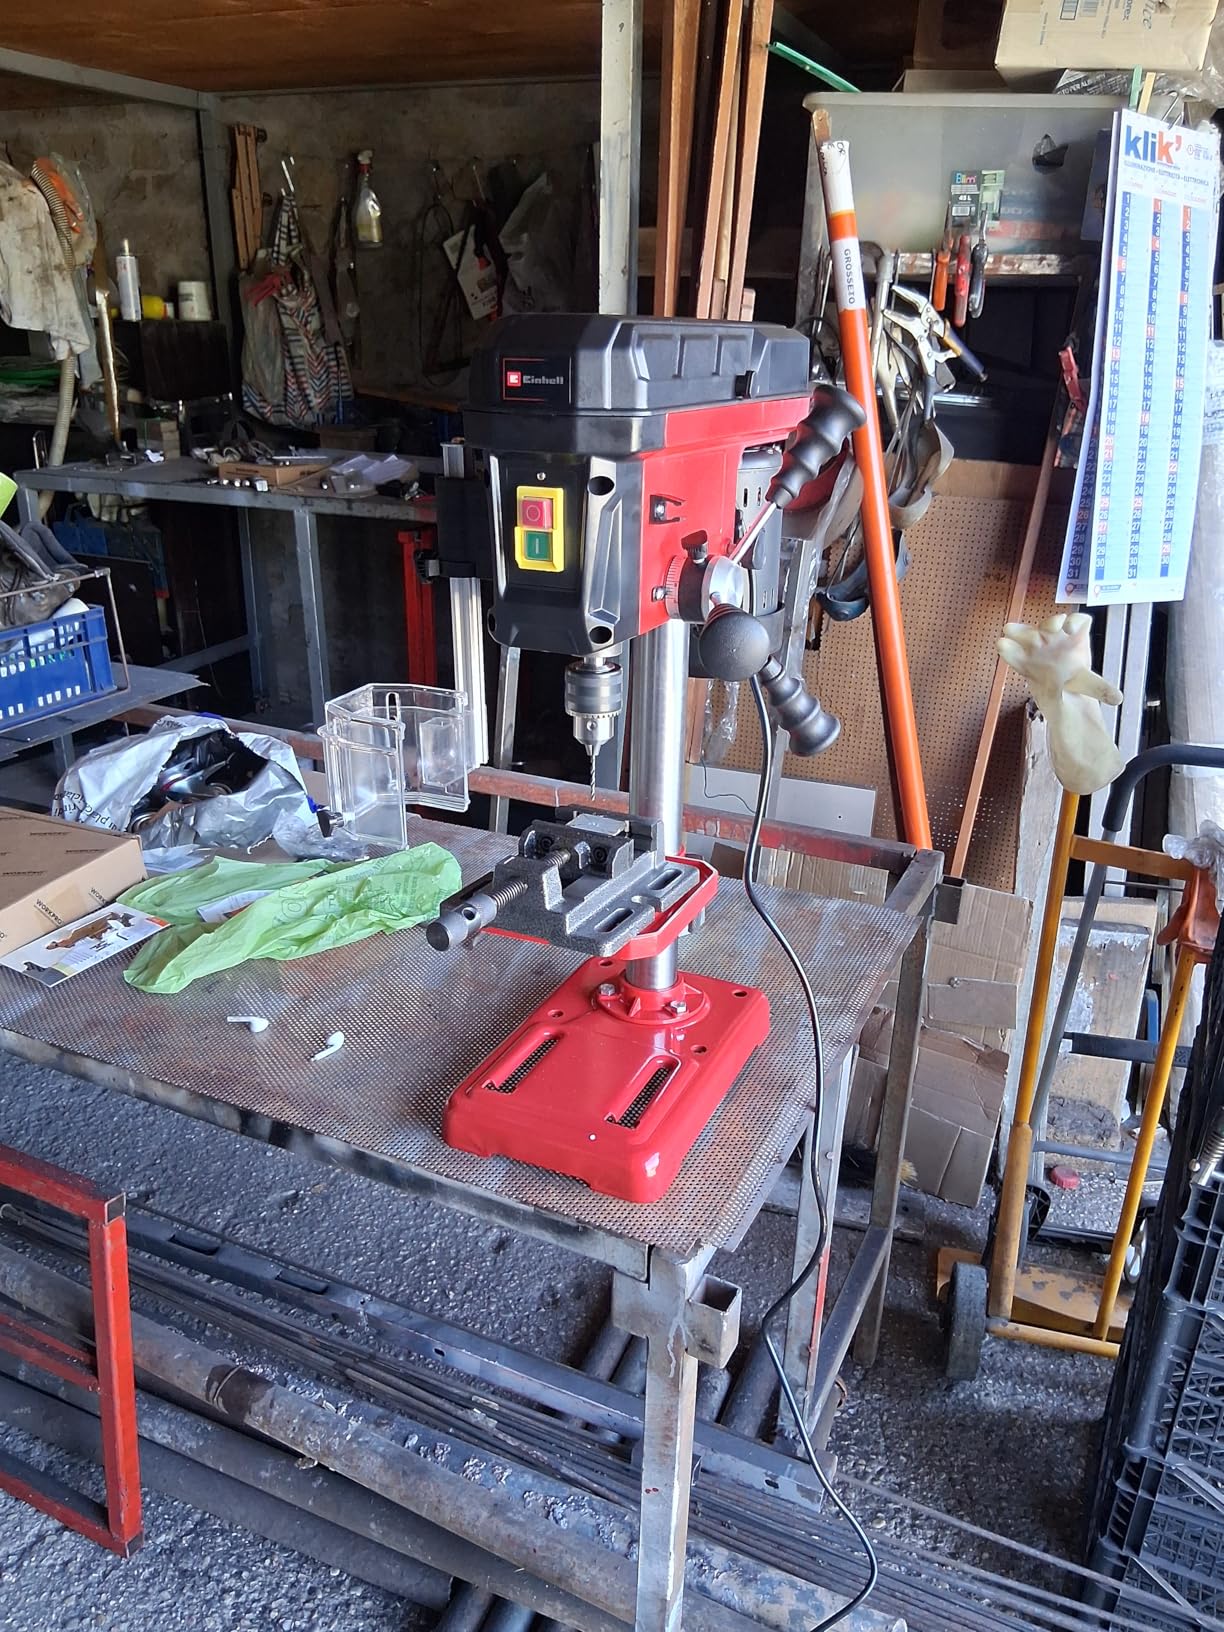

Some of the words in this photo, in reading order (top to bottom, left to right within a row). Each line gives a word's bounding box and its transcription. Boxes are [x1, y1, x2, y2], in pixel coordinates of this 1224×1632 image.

[844, 248, 855, 304] GROSSETO
[1115, 310, 1124, 320] 10
[1179, 318, 1187, 328] 10
[1114, 324, 1122, 333] 11
[1147, 326, 1154, 336] 11
[1179, 330, 1186, 340] 11
[1113, 336, 1121, 346] 12
[1146, 339, 1154, 349] 12
[1178, 342, 1186, 352] 12
[1146, 352, 1154, 361] 13
[1178, 355, 1185, 364] 13
[1111, 361, 1120, 370] 14
[1145, 364, 1153, 374] 14
[1177, 366, 1184, 376] 14
[523, 376, 564, 385] Einhell
[1110, 375, 1119, 384] 15
[1145, 376, 1153, 385] 15
[1110, 386, 1118, 395] 16
[1144, 389, 1152, 398] 16
[1175, 391, 1184, 400] 16
[1109, 400, 1117, 409] 17
[1143, 401, 1151, 410] 17
[1175, 403, 1183, 412] 17
[1107, 424, 1115, 433] 19
[1141, 426, 1149, 435] 19
[1173, 426, 1181, 436] 19
[1139, 438, 1148, 446] 20
[1171, 439, 1180, 448] 20
[1104, 450, 1113, 459] 21
[1138, 451, 1146, 460] 21
[1170, 451, 1179, 460] 21
[1103, 461, 1112, 470] 22
[1137, 462, 1146, 470] 22
[1169, 462, 1178, 470] 22
[1101, 486, 1110, 495] 24
[1135, 486, 1144, 495] 24
[1167, 486, 1176, 495] 24
[1099, 511, 1108, 519] 26
[1132, 522, 1140, 530] 27
[1164, 522, 1173, 530] 27
[1096, 546, 1106, 555] 29
[1130, 546, 1139, 554] 29
[1096, 558, 1105, 567] 30
[1129, 558, 1138, 566] 30
[1128, 568, 1137, 577] 31
[36, 898, 62, 924] WORKPRO
